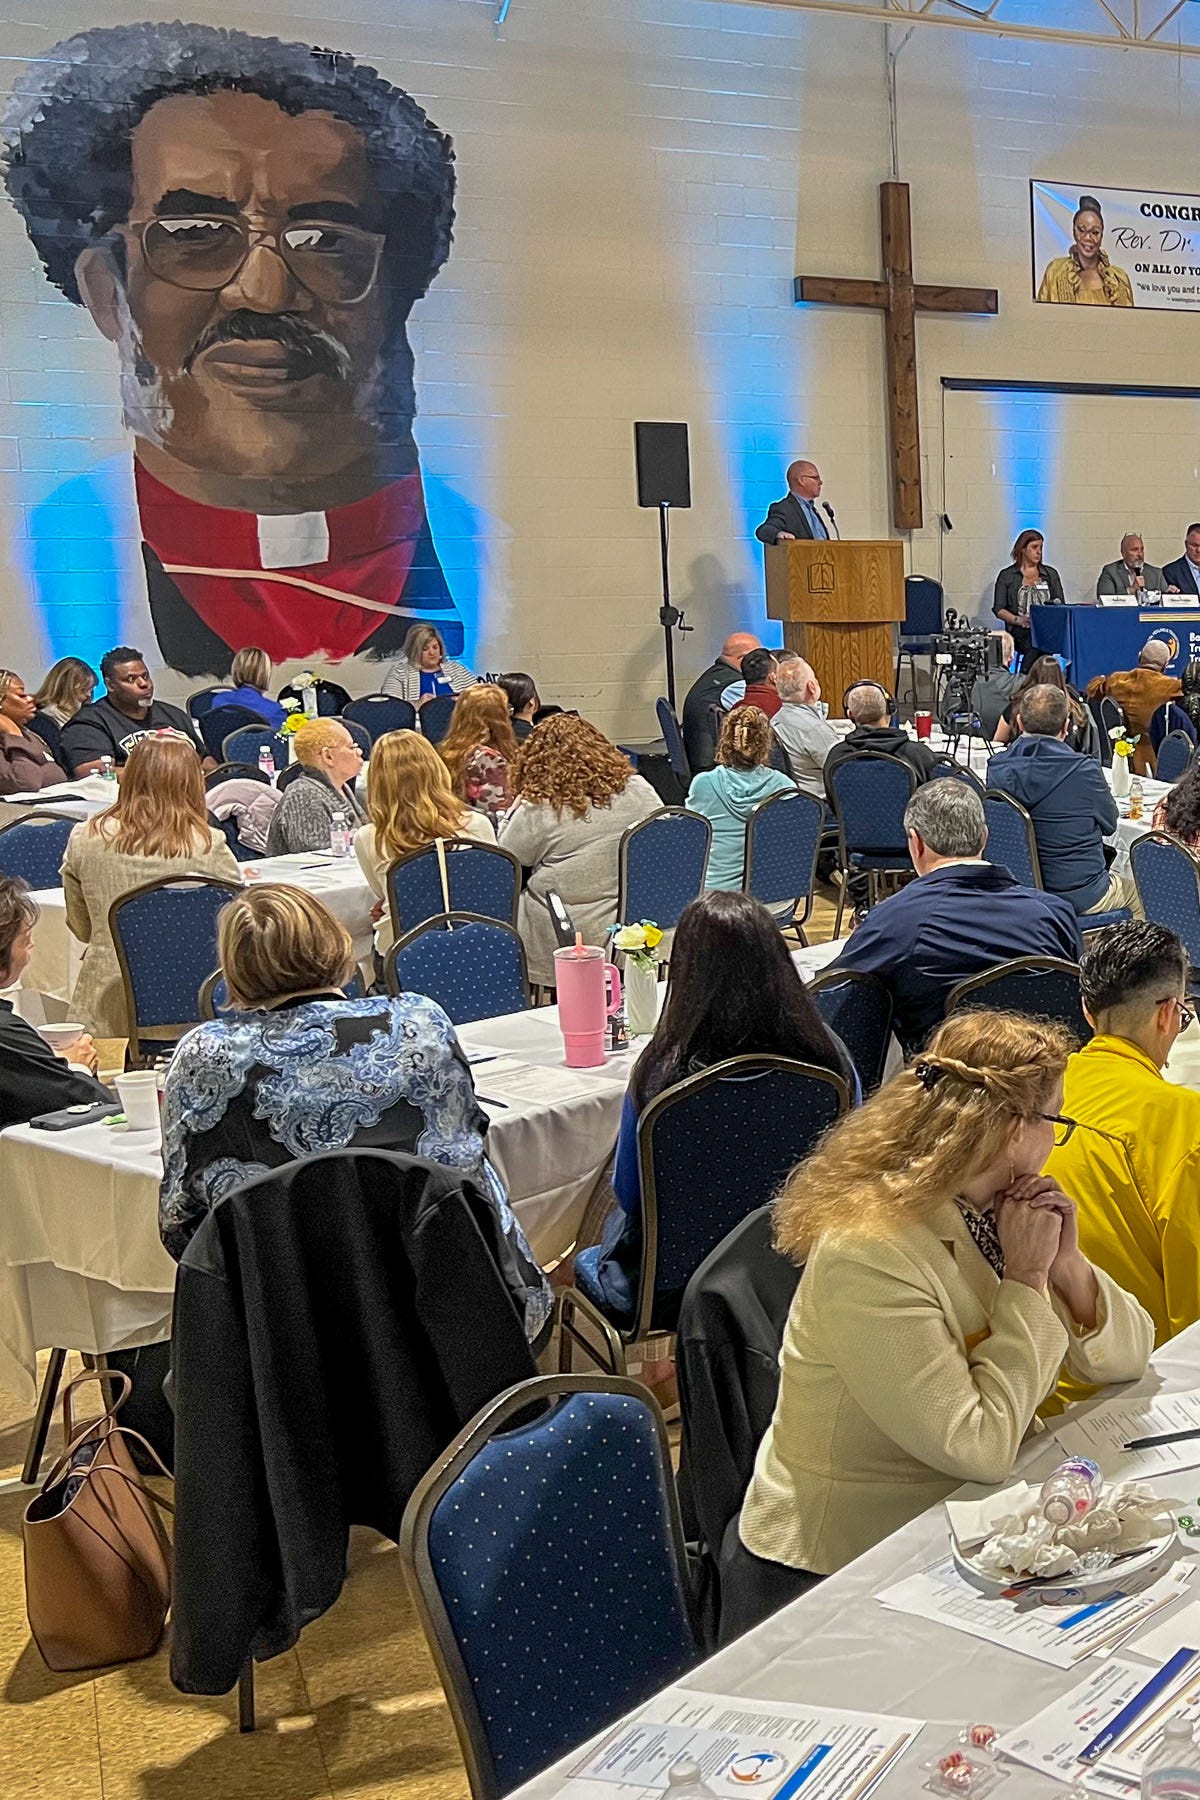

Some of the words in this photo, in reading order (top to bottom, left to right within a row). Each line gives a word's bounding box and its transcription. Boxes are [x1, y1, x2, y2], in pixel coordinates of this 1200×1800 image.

[1111, 227, 1151, 249] Rev.
[1159, 230, 1194, 253] Dr.
[1134, 263, 1150, 273] ON
[1152, 264, 1172, 275] ALL
[1173, 265, 1187, 275] OF
[1151, 284, 1166, 292] love
[1167, 286, 1180, 295] you
[1182, 286, 1195, 294] and
